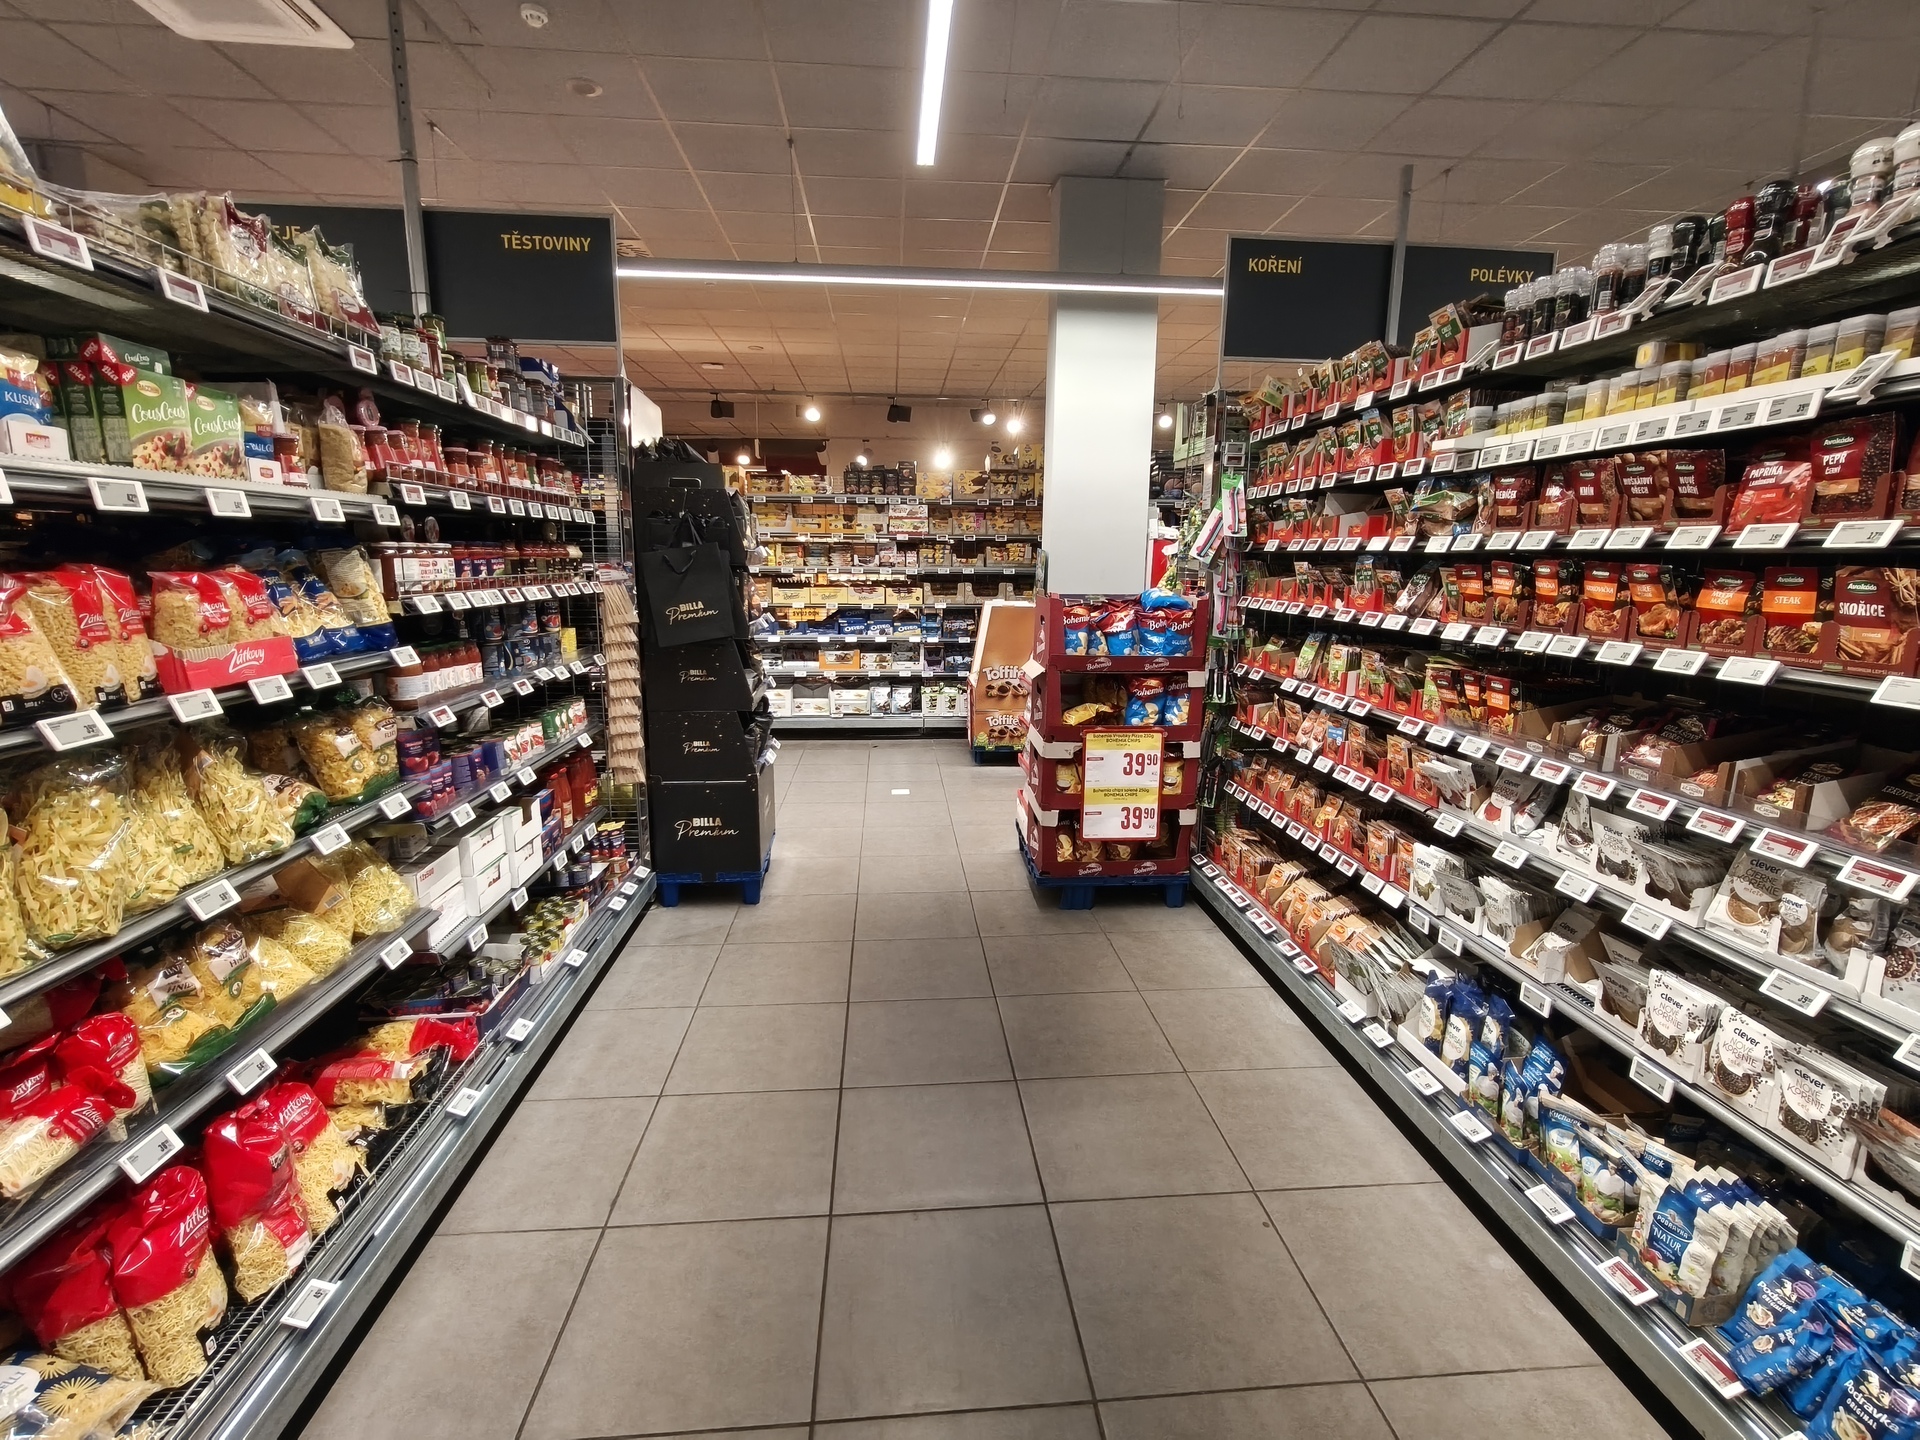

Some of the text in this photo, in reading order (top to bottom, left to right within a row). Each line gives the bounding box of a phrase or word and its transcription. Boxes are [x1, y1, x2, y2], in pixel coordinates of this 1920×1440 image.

[501, 230, 591, 252] TĚSTOVINY
[1248, 255, 1302, 274] KOŘENÍ
[1470, 266, 1534, 284] POLÉVKY
[131, 401, 186, 424] CousCous
[194, 414, 240, 436] CousCous
[1824, 436, 1854, 446] Avokádo
[1679, 475, 1695, 485] NOVÉ
[1749, 466, 1783, 479] PAPRIKA
[1847, 583, 1877, 591] Avokádo
[679, 601, 704, 612] BILLA
[1774, 596, 1801, 605] STEAK
[1839, 601, 1886, 617] SKOŘICE
[665, 606, 719, 626] Premium
[228, 648, 265, 674] Zátkovy
[1086, 661, 1112, 671] Bohemia
[1144, 661, 1169, 671] Bohemia
[1504, 779, 1521, 788] clever
[674, 820, 739, 840] Premium
[692, 818, 722, 827] BILLA
[1604, 826, 1623, 837] clever
[1078, 866, 1102, 876] Bohemia
[1133, 866, 1157, 876] Bohemia
[1750, 858, 1781, 875] clever
[1782, 896, 1803, 909] clever
[1560, 921, 1578, 935] clever
[1661, 992, 1683, 1010] clever
[1733, 1027, 1760, 1047] clever
[1794, 1068, 1826, 1089] clever
[1657, 1214, 1691, 1240] PODRAVKA
[1652, 1225, 1682, 1257] NATUR
[1757, 1280, 1797, 1314] Podravka
[1844, 1379, 1900, 1434] Podravka
[1846, 1398, 1877, 1430] ORIGINAL
